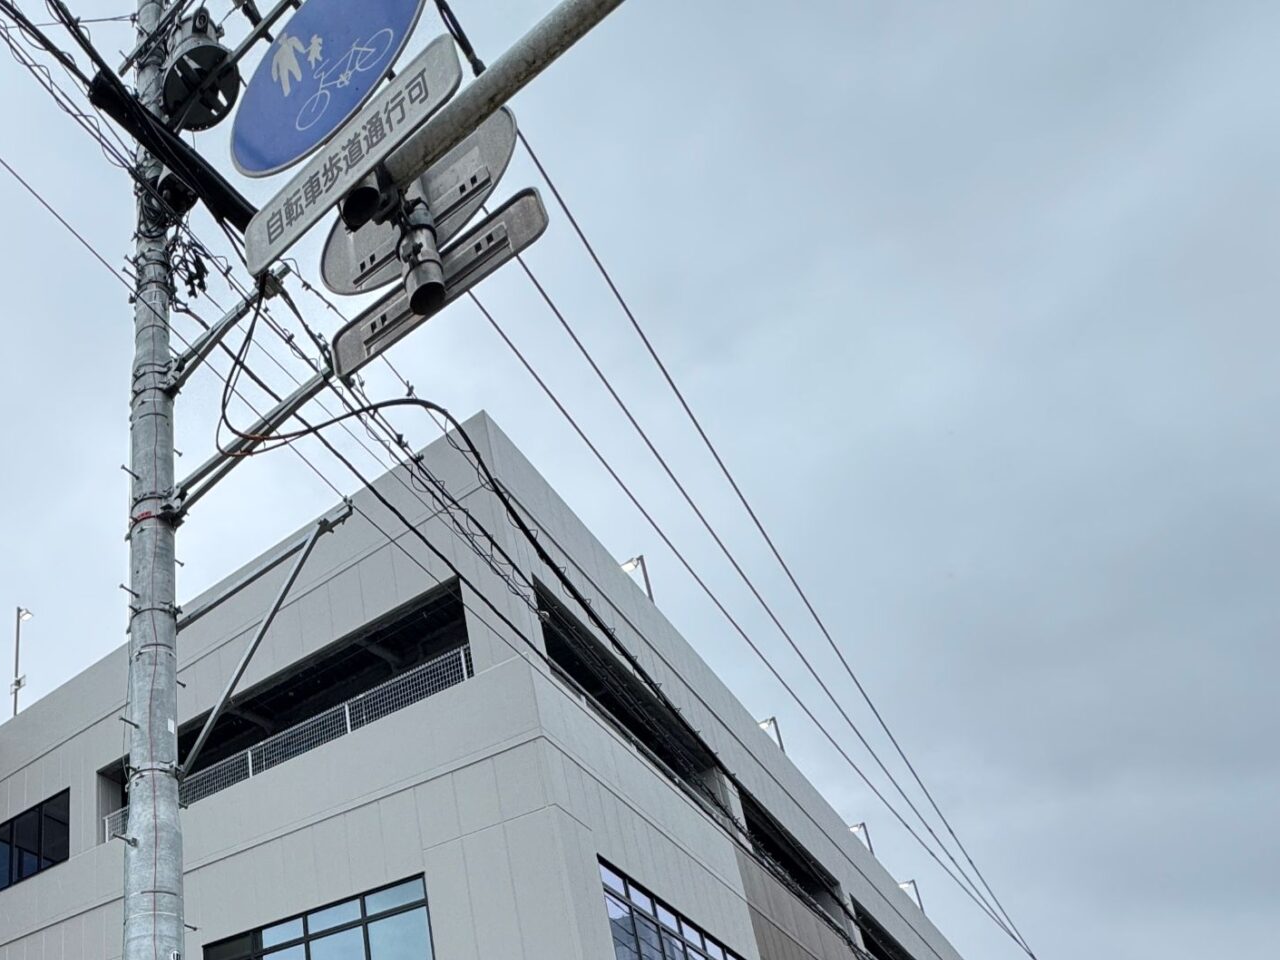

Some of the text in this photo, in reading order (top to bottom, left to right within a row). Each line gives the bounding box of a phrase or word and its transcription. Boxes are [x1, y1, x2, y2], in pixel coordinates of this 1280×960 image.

[266, 69, 430, 245] 自転車歩道通行可
